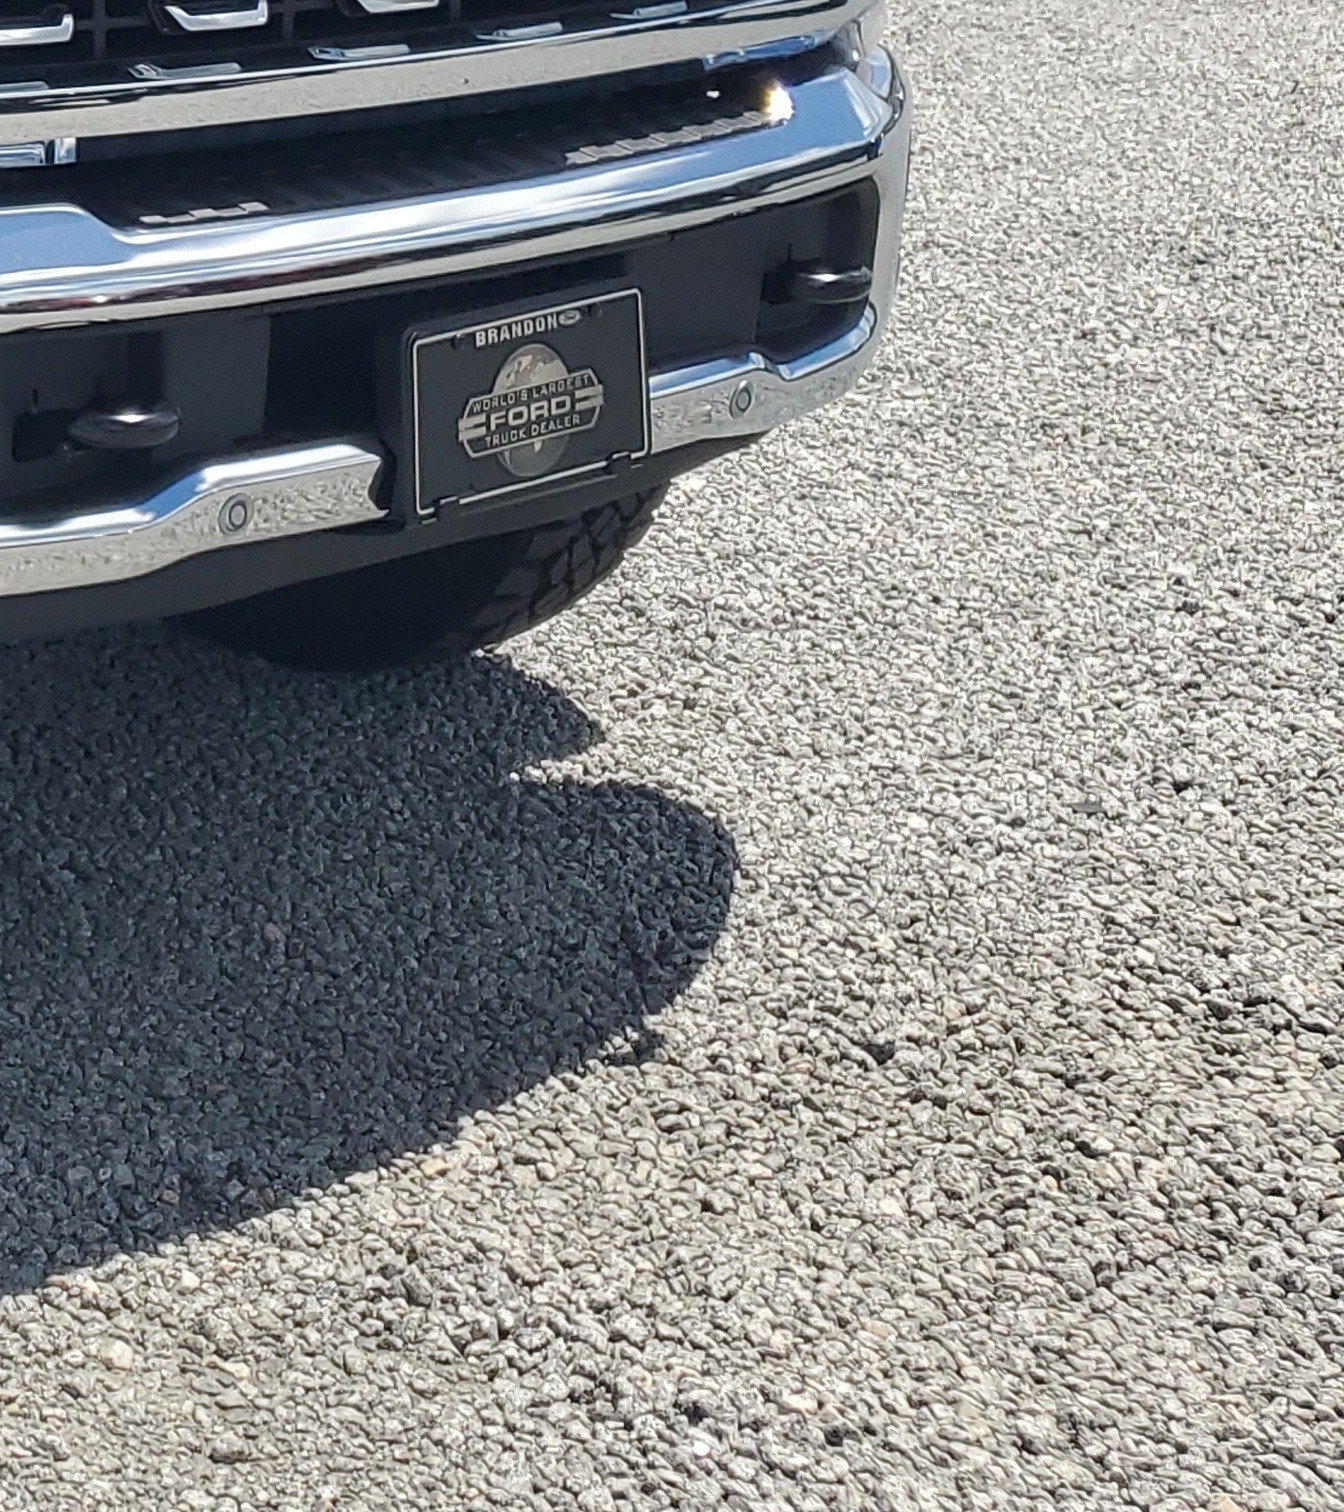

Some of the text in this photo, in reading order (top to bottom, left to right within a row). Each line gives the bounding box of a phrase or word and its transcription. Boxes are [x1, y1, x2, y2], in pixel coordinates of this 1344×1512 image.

[475, 313, 559, 348] BRANDON
[472, 374, 590, 413] WORLD'S LARGEST
[490, 394, 572, 431] FORD
[484, 413, 580, 449] TRUCK DEALER
